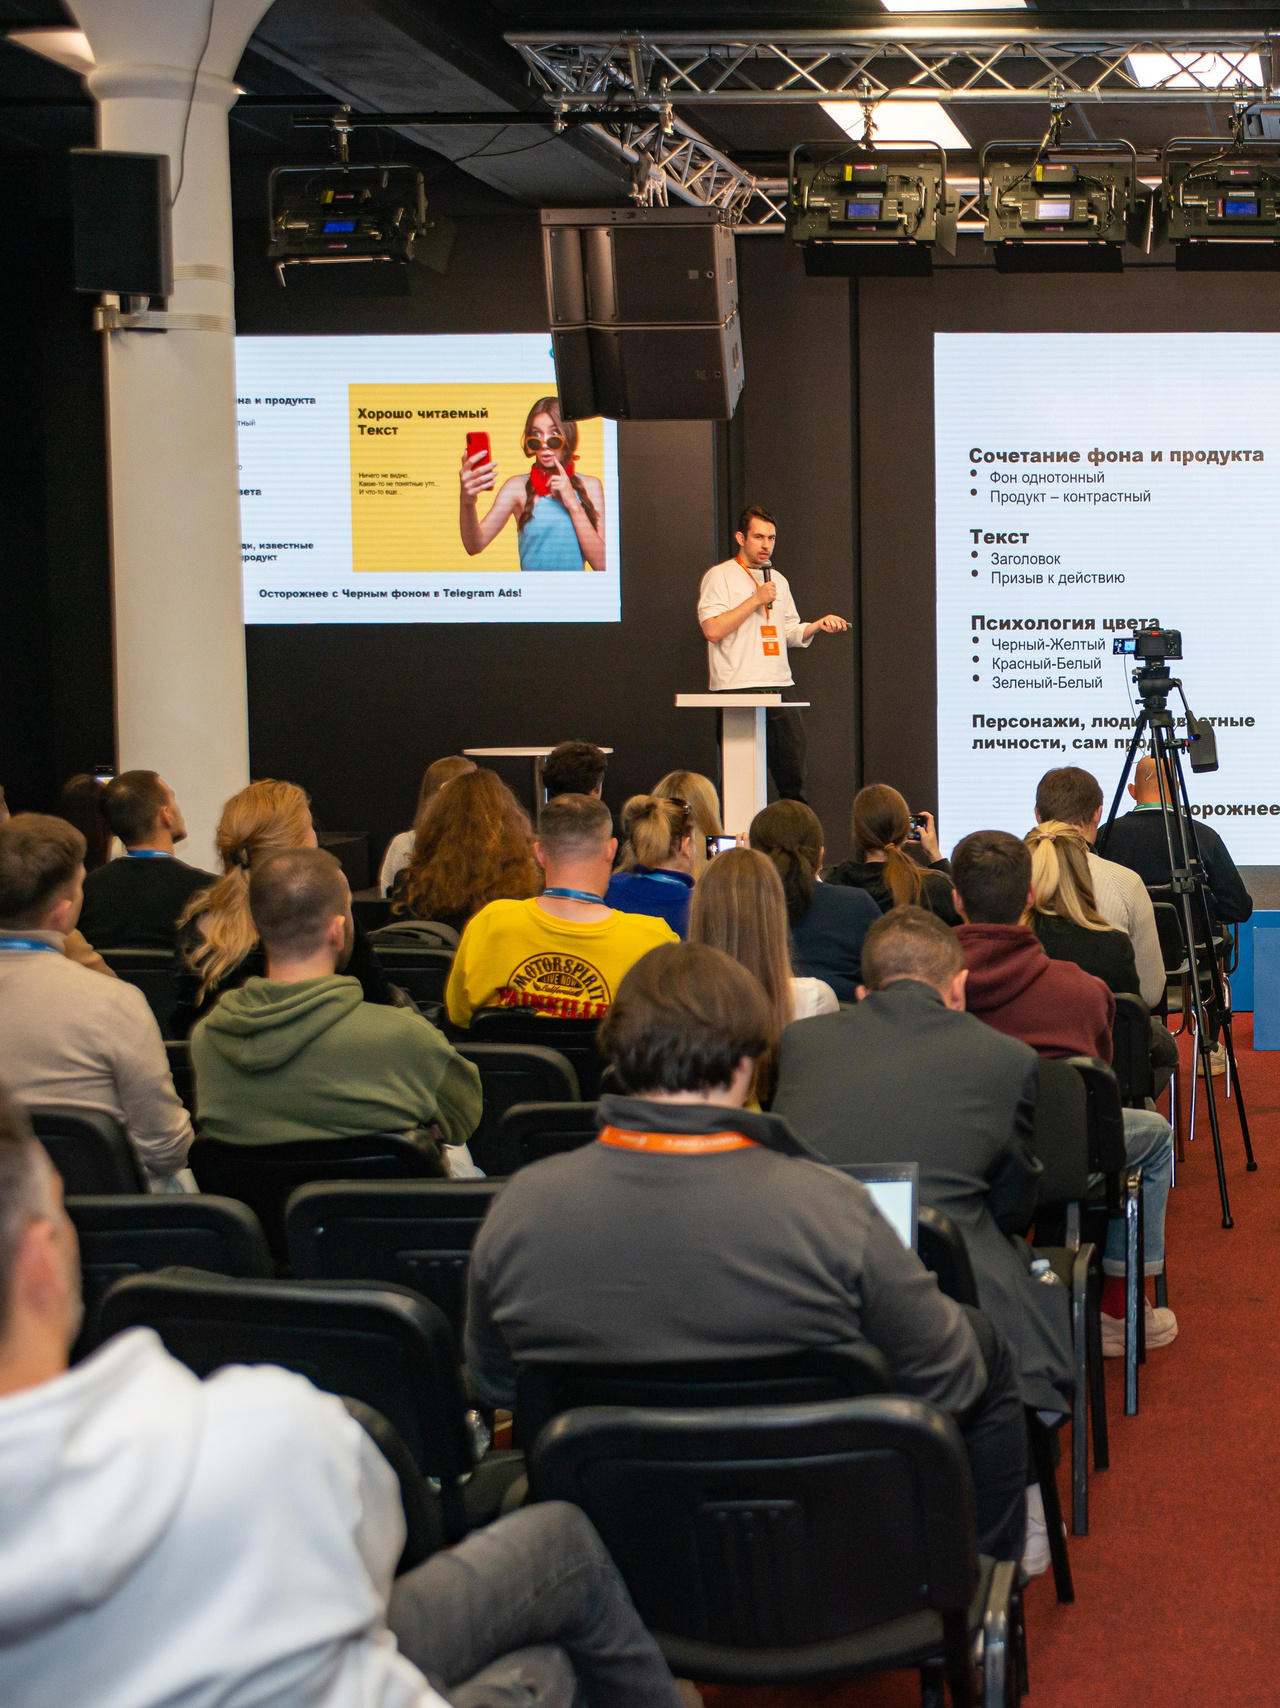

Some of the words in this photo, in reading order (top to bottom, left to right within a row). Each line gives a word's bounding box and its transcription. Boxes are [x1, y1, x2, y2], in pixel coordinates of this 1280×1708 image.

[236, 397, 252, 405] на
[357, 407, 414, 421] Хорошо
[416, 407, 489, 420] читаемый
[357, 424, 399, 436] Текст
[968, 447, 1081, 464] Сочетание
[1087, 447, 1144, 467] фона
[1150, 450, 1163, 463] и
[1169, 449, 1265, 467] продукта
[989, 470, 1018, 484] Фон
[1021, 470, 1105, 486] однотонный
[238, 488, 262, 497] вета
[990, 489, 1047, 507] Продукт
[1063, 489, 1151, 506] контрастный
[969, 528, 1030, 545] Текст
[241, 541, 256, 551] ди,
[258, 542, 315, 550] известные
[990, 551, 1061, 566] Заголовок
[991, 570, 1044, 588] Призыв
[1047, 573, 1055, 584] к
[1057, 571, 1126, 587] действию
[258, 588, 329, 601] Осторожнее
[331, 590, 339, 599] с
[341, 588, 388, 600] Черным
[390, 588, 431, 600] фоном
[433, 590, 440, 598] в
[442, 588, 495, 600] Telegram
[497, 588, 522, 598] Ads!
[971, 614, 1096, 631] Психология
[1102, 617, 1160, 633] цвета
[991, 637, 1106, 653] Черный-Желтый
[992, 656, 1102, 673] Красный-Белый
[992, 675, 1103, 690] Зеленый-Белый
[972, 713, 1086, 732] Персонажи,
[971, 738, 1067, 752] личности,
[1071, 738, 1108, 750] сам
[512, 956, 608, 1003] MOTORSPIRIT
[543, 973, 559, 985] LIVE
[561, 974, 579, 988] NOW
